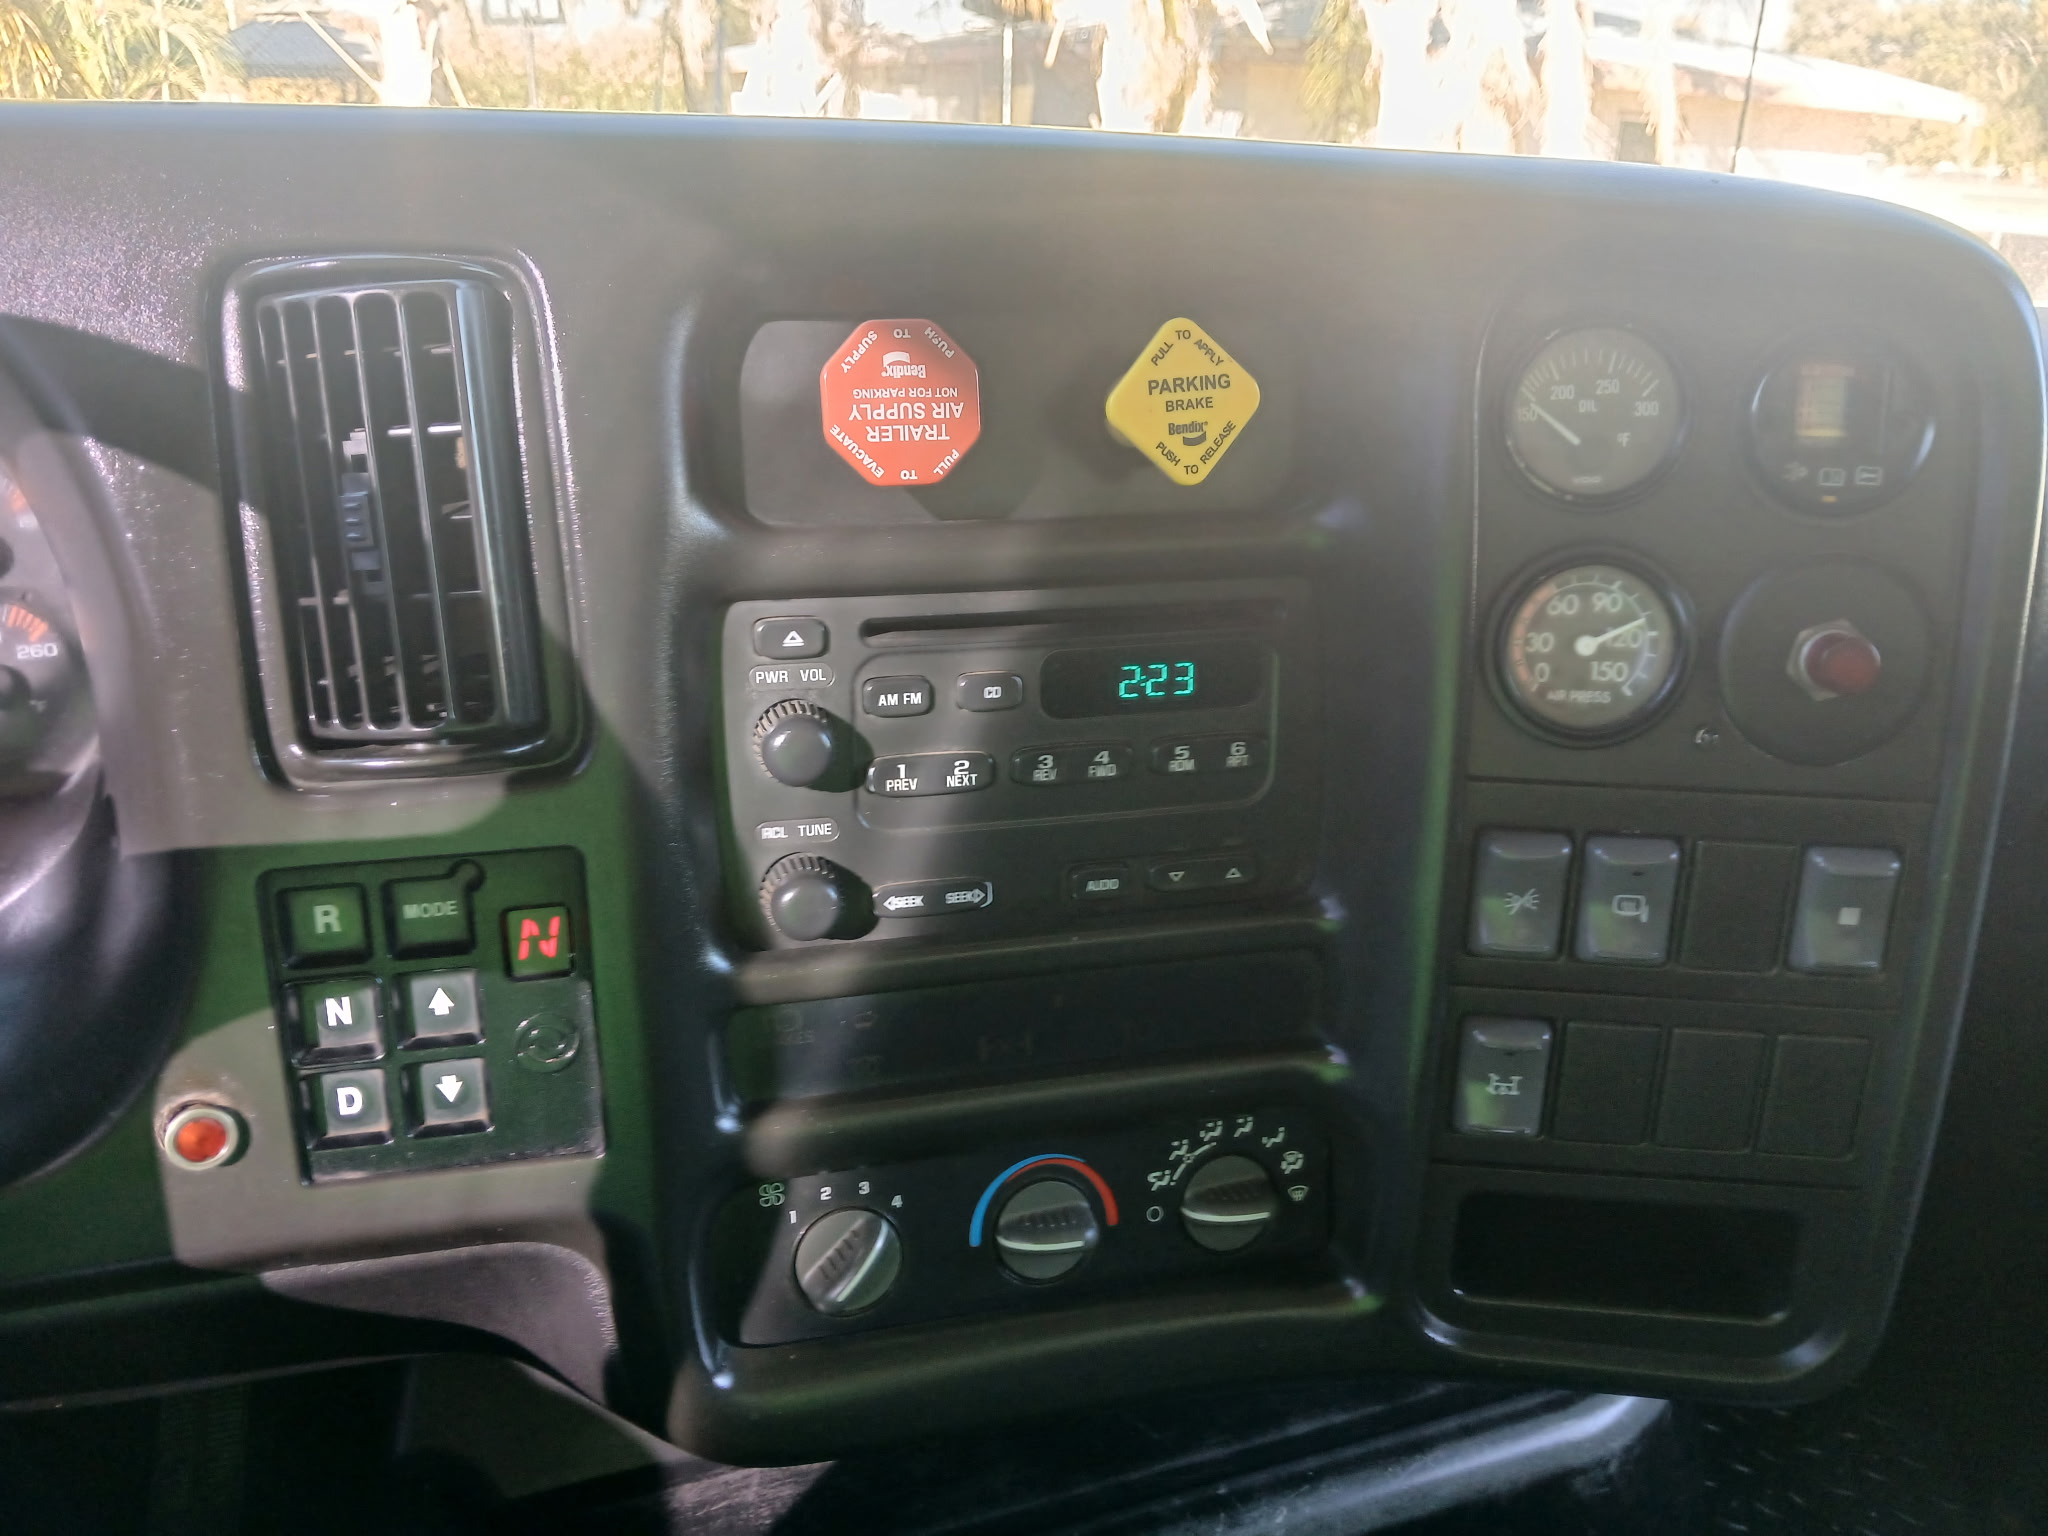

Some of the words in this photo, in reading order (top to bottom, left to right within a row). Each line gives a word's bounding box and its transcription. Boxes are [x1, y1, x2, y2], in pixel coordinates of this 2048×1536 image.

[893, 328, 911, 339] TO
[924, 326, 955, 359] PUSH
[1151, 341, 1175, 366] PULL
[1175, 329, 1191, 340] TO
[1193, 339, 1225, 367] APPLY
[840, 330, 878, 374] SUPPLY
[885, 364, 926, 379] Bendix
[908, 387, 932, 397] FOR
[935, 387, 958, 397] NOT
[1147, 373, 1231, 395] PARKING
[1551, 385, 1575, 399] 200
[1595, 379, 1620, 394] 250
[853, 388, 905, 399] PARKING
[848, 403, 926, 421] SUPPLY
[931, 402, 964, 419] AIR
[1165, 397, 1214, 413] BRAKE
[1578, 400, 1597, 413] OIL
[1634, 401, 1660, 417] 300
[865, 424, 950, 442] TRAILER
[1168, 421, 1204, 436] Bendix
[829, 424, 885, 478] EVACUATE
[1155, 441, 1181, 466] PUSH
[1184, 465, 1199, 475] TO
[1199, 420, 1237, 464] RELEASE
[933, 449, 960, 475] PULL
[900, 470, 918, 480] TO
[1546, 594, 1580, 615] 60
[1592, 591, 1623, 612] 90
[1525, 632, 1555, 652] 30
[16, 642, 58, 660] 260
[755, 670, 789, 684] PWR
[800, 668, 827, 682] VOL
[1534, 663, 1551, 682] 0
[1590, 661, 1628, 682] 150
[1119, 662, 1195, 698] 2:23
[878, 694, 898, 706] AM
[903, 692, 922, 705] FM
[984, 686, 1001, 698] CD
[1570, 690, 1611, 703] PRESS
[1093, 750, 1110, 764] 4
[1174, 745, 1190, 759] 5
[1230, 742, 1246, 756] 6
[953, 759, 970, 775] 2
[1037, 755, 1054, 769] 3
[896, 764, 906, 779] 1
[886, 778, 918, 792] PREV
[946, 773, 978, 788] NEXT
[797, 823, 832, 837] TUNE
[403, 900, 458, 920] MODE
[313, 904, 342, 934] R
[517, 916, 561, 961] N
[325, 996, 353, 1026] N
[336, 1086, 363, 1116] D
[820, 1186, 832, 1200] 2
[858, 1181, 870, 1195] 3
[891, 1194, 903, 1208] 4
[789, 1210, 797, 1224] 1
